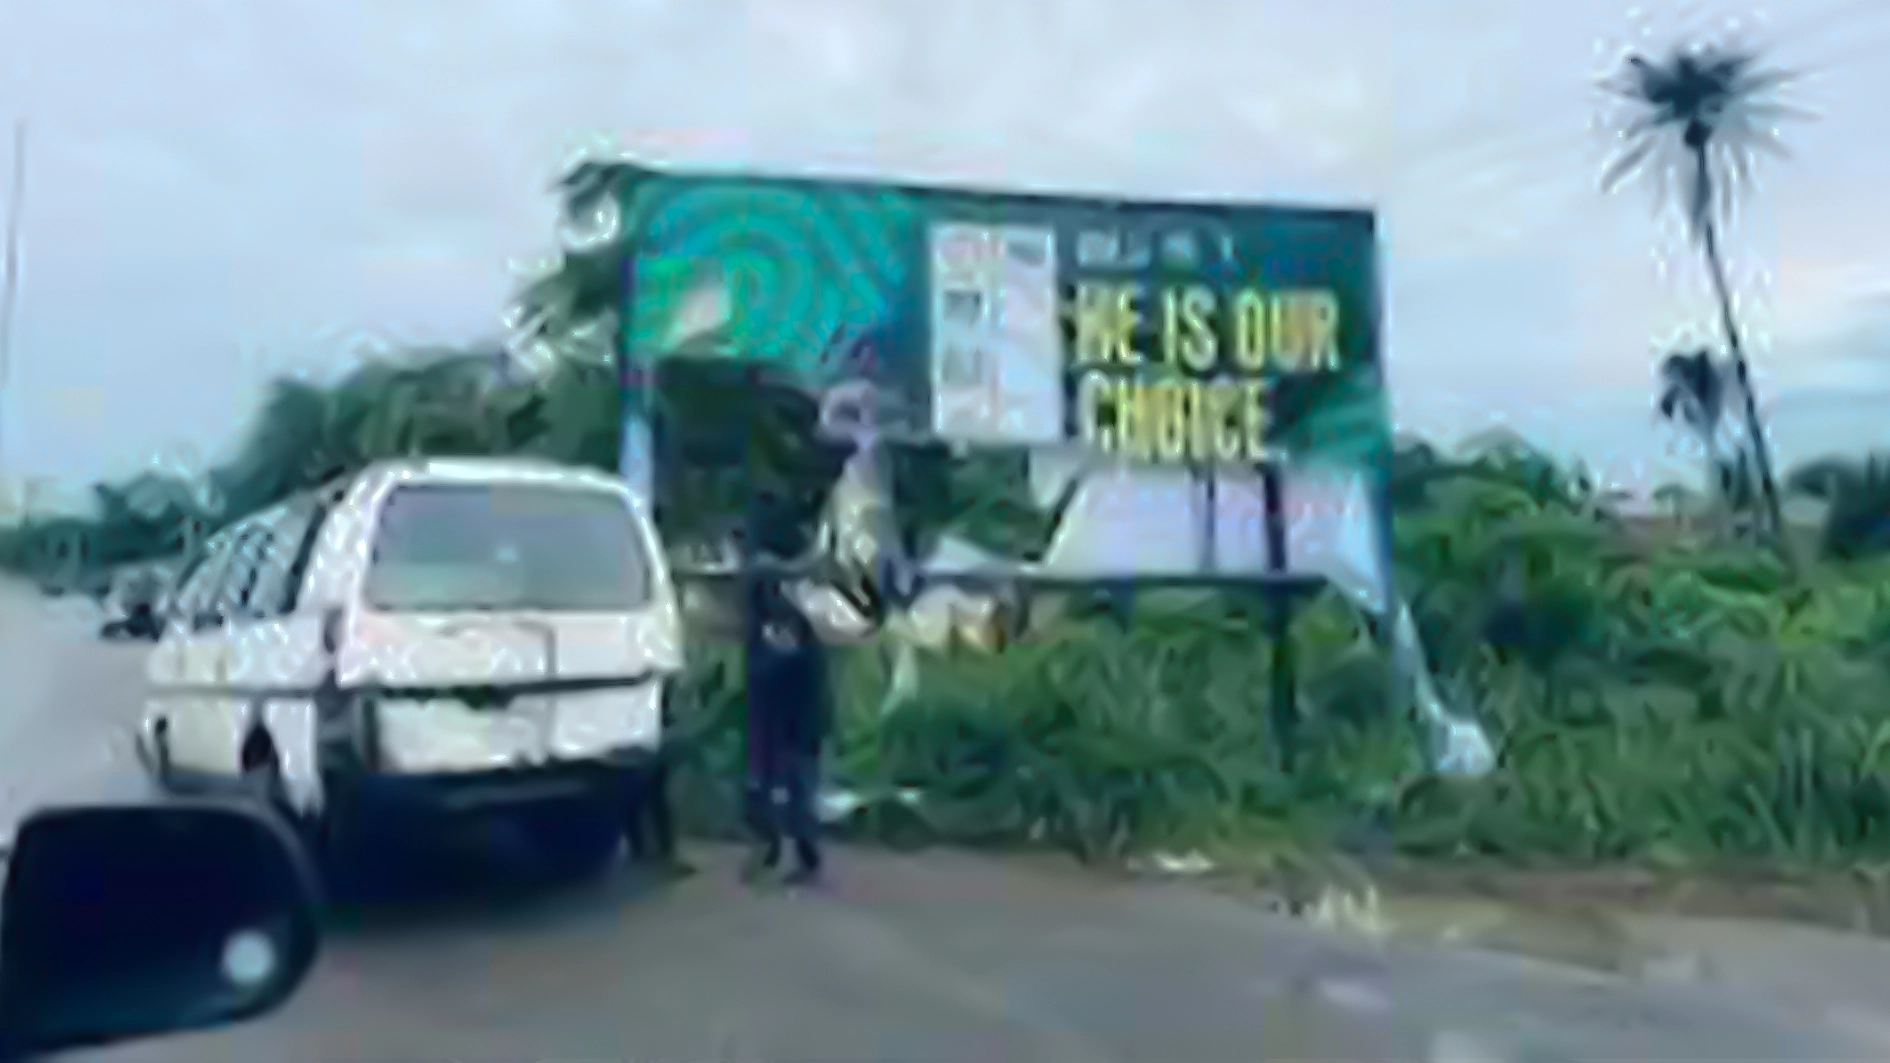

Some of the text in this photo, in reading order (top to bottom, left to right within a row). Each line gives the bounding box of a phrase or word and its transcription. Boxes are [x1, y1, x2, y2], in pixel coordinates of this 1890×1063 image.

[1164, 284, 1218, 372] IS
[1236, 286, 1340, 373] OUR
[1077, 370, 1276, 461] CHOICE
